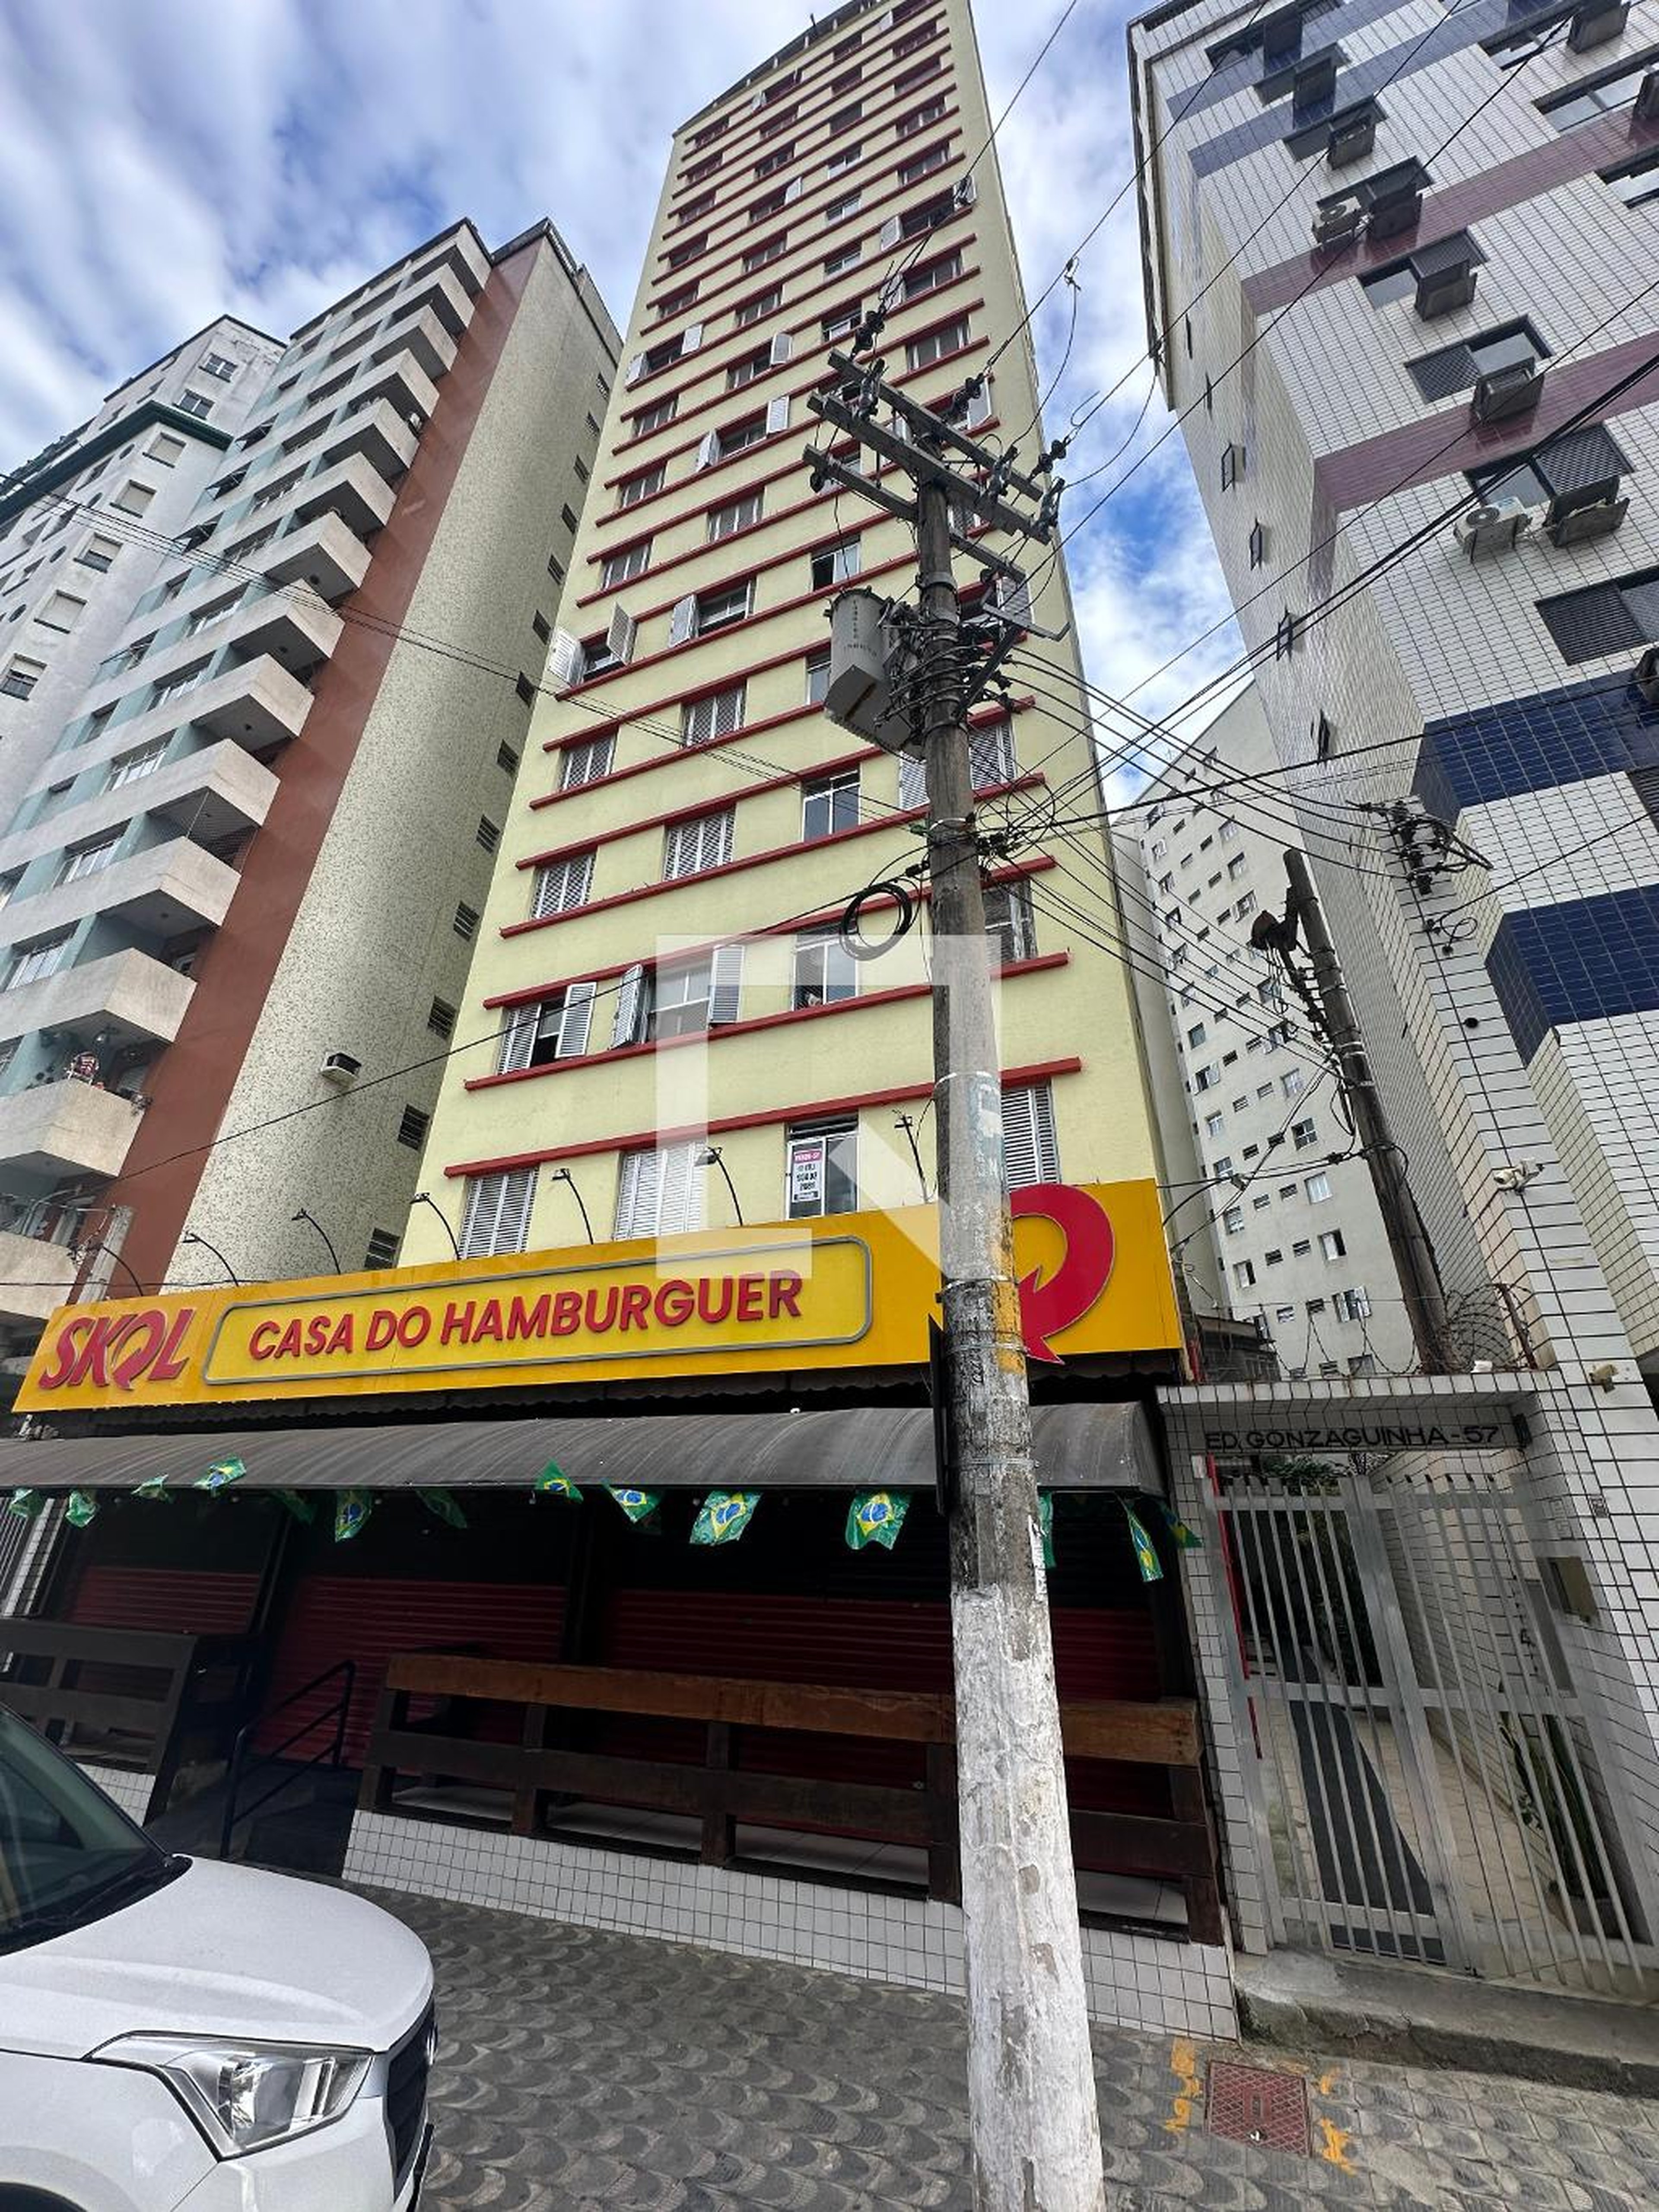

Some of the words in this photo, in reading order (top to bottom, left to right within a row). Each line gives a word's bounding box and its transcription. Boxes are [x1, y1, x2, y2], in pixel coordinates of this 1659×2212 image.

[39, 1307, 196, 1391] SKOL
[249, 1314, 353, 1360] CASA
[365, 1305, 432, 1351] DO
[441, 1270, 803, 1345] HAMBURGUER
